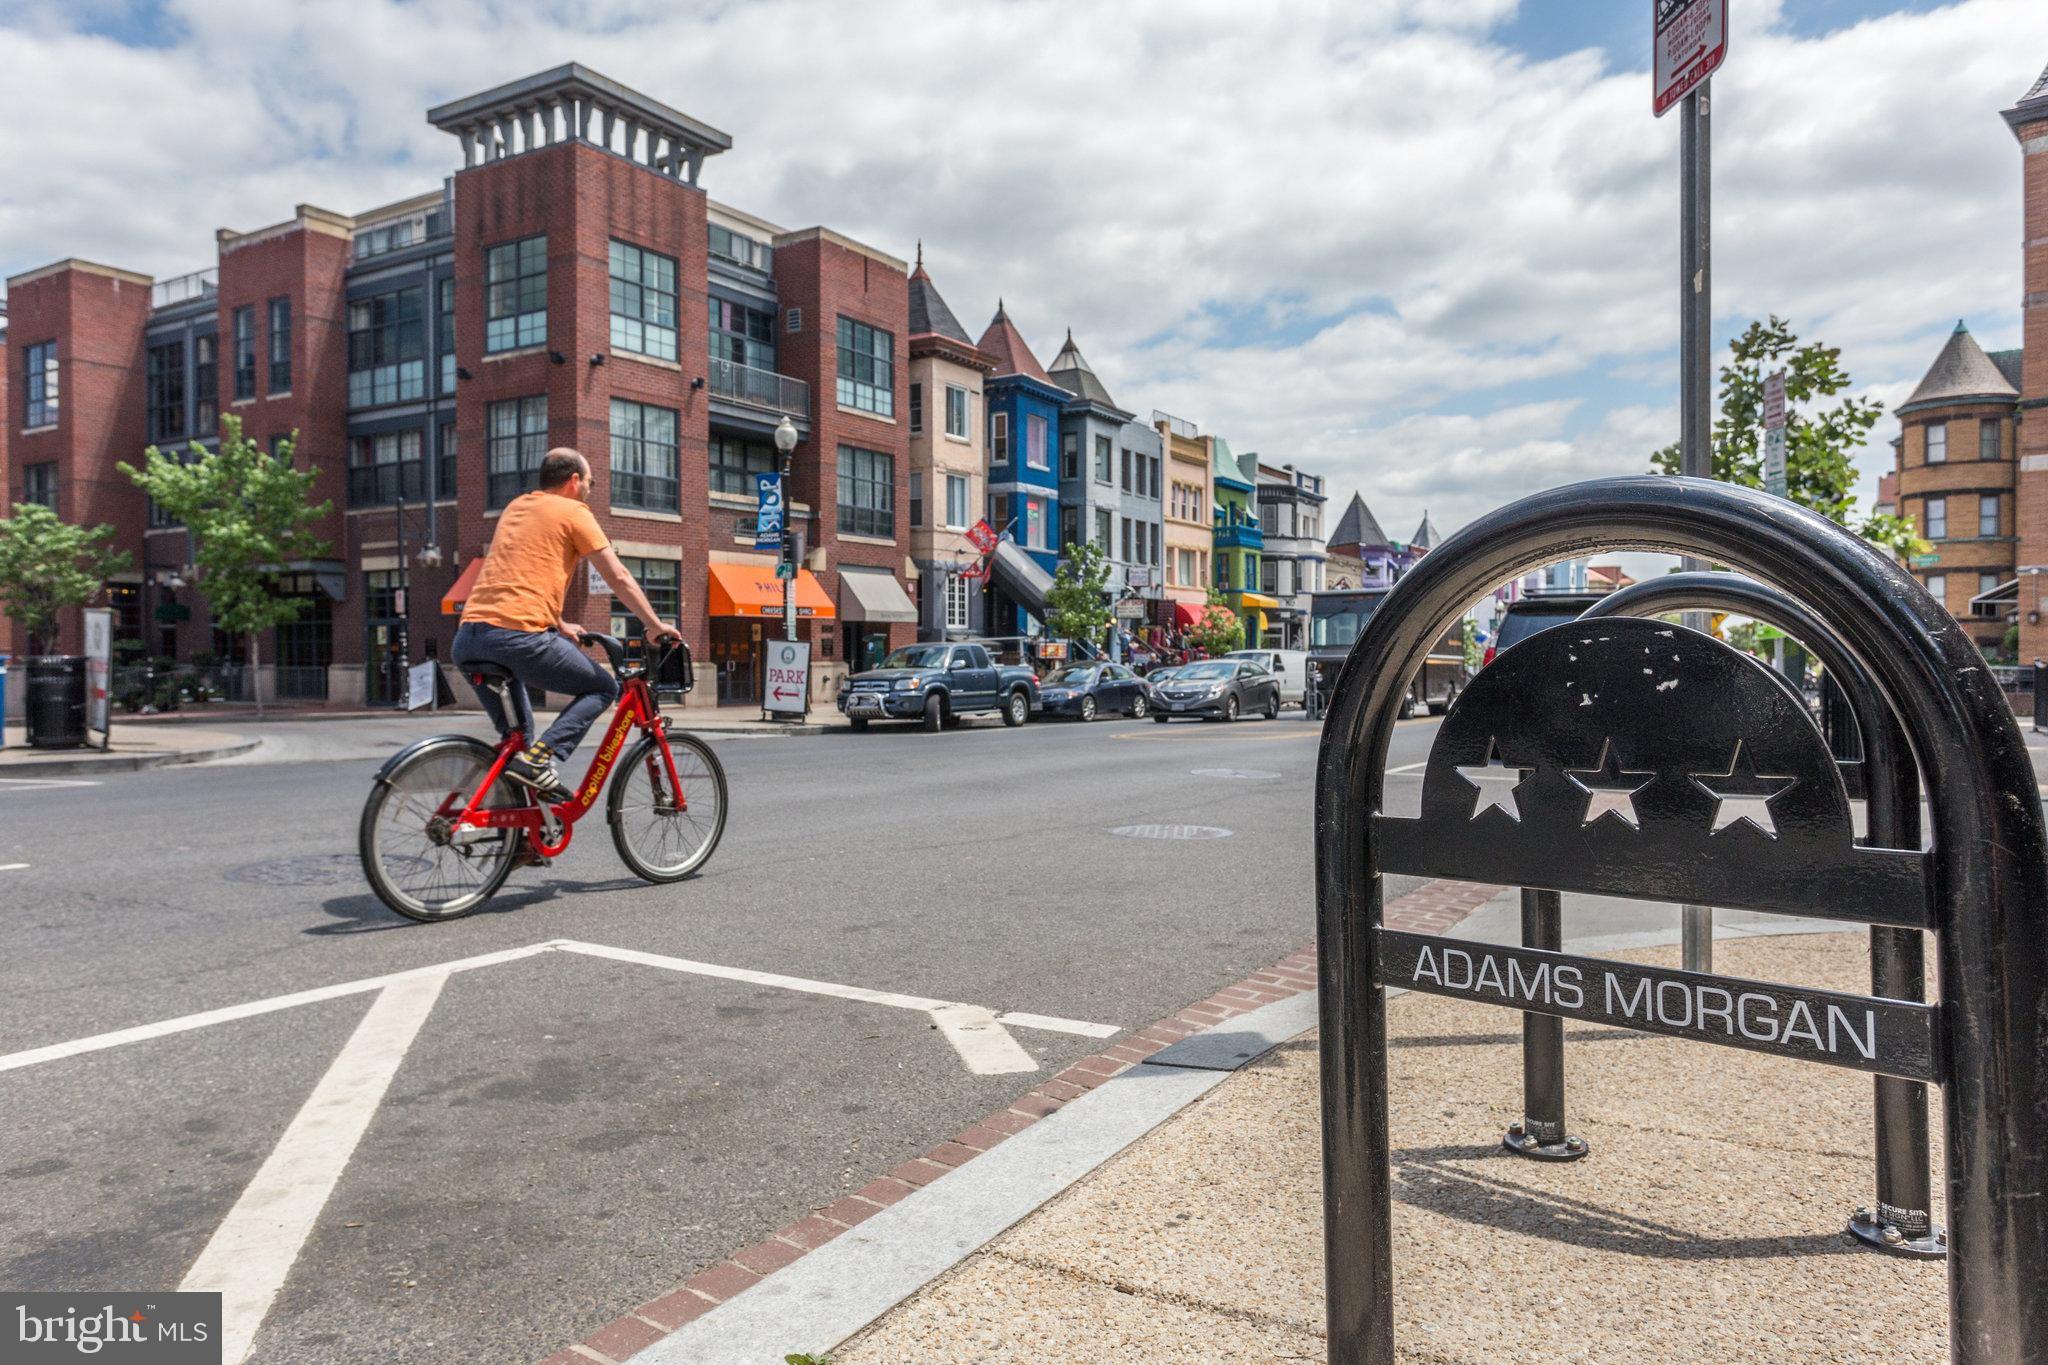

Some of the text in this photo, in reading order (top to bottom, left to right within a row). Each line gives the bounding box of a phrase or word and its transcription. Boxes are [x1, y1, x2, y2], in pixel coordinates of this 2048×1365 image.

[1673, 30, 1706, 63] SATURDAY
[1690, 64, 1705, 84] CALL
[760, 479, 781, 530] SHOP
[769, 668, 805, 684] PARK
[582, 709, 635, 806] capital bikeshare
[1413, 945, 1876, 1059] ADAMS MORGAN
[1881, 1202, 1906, 1214] SECURE
